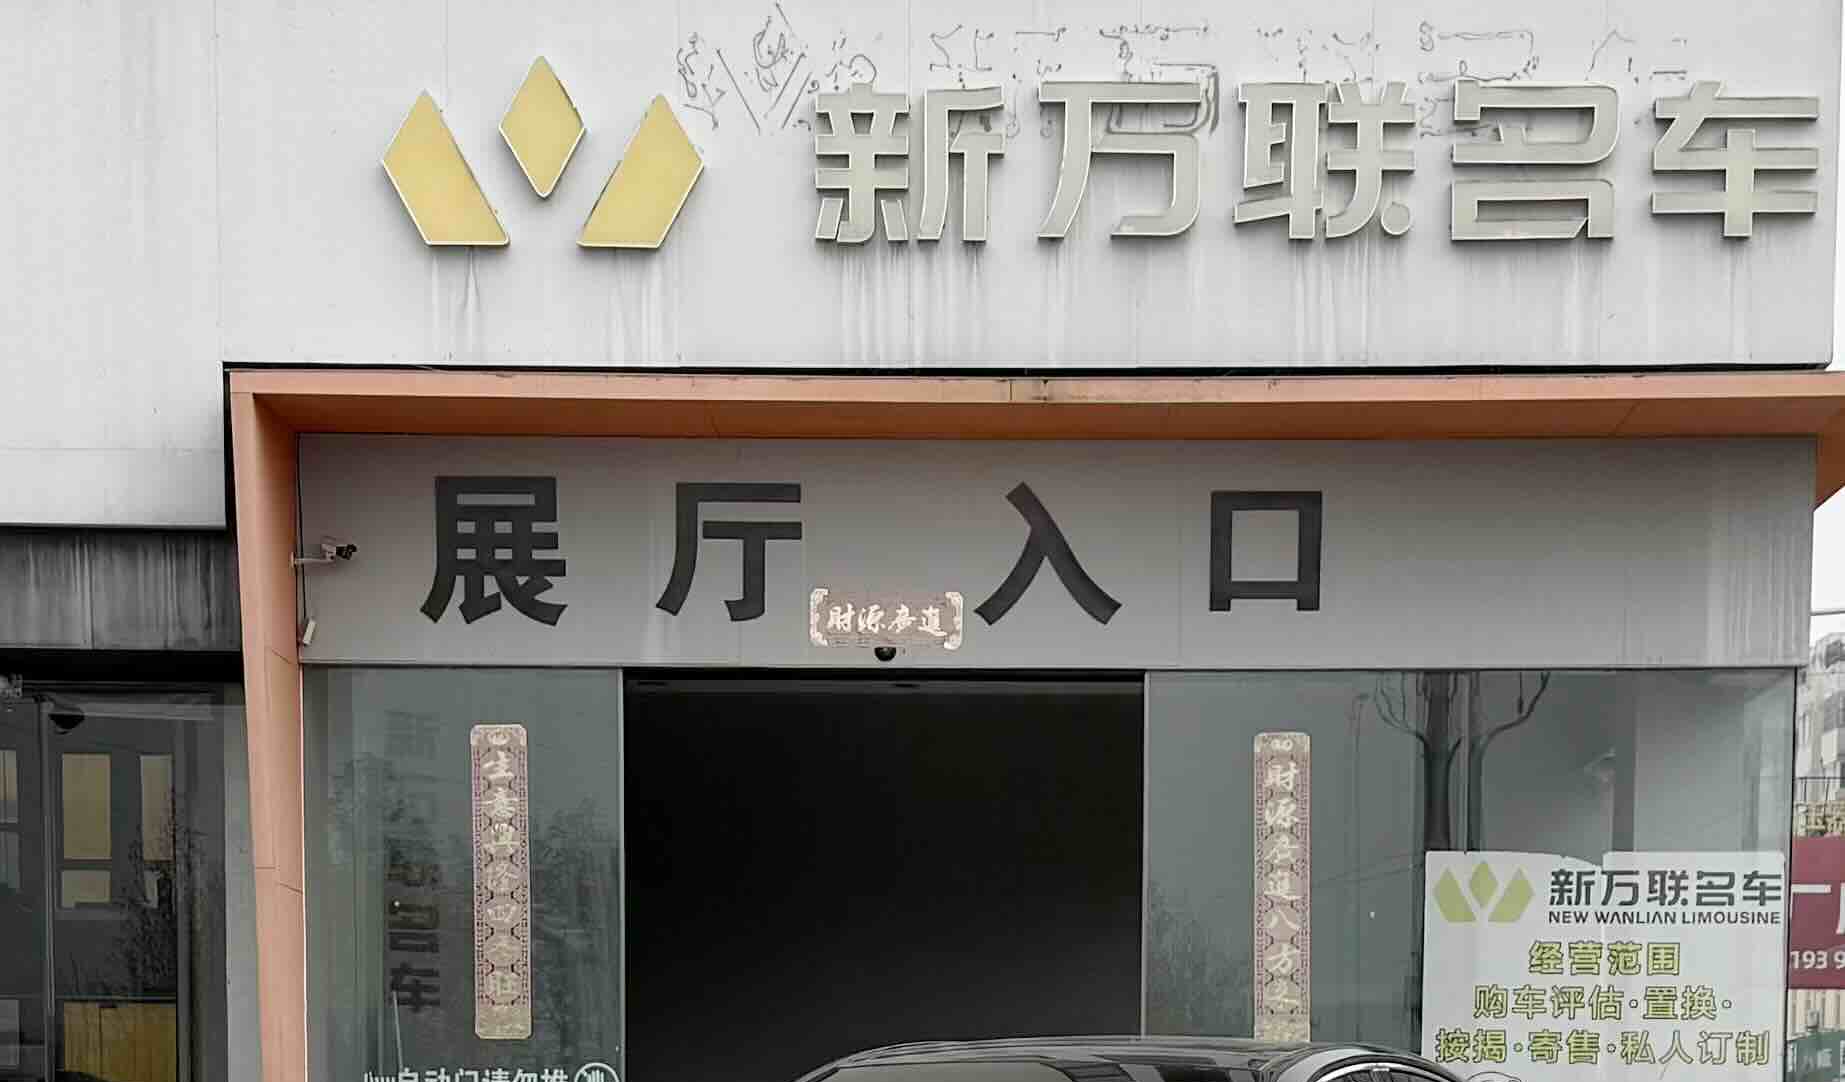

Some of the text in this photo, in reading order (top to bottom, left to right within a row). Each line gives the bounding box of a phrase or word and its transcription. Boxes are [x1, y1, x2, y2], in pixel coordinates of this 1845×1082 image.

[814, 79, 1820, 243] 新万联名车
[421, 475, 1322, 625] 展厅入口
[1548, 869, 1782, 907] 新万联名车
[1548, 911, 1781, 924] NEW WANLIAN LIMOUSINE
[1528, 939, 1681, 977] 经营范围
